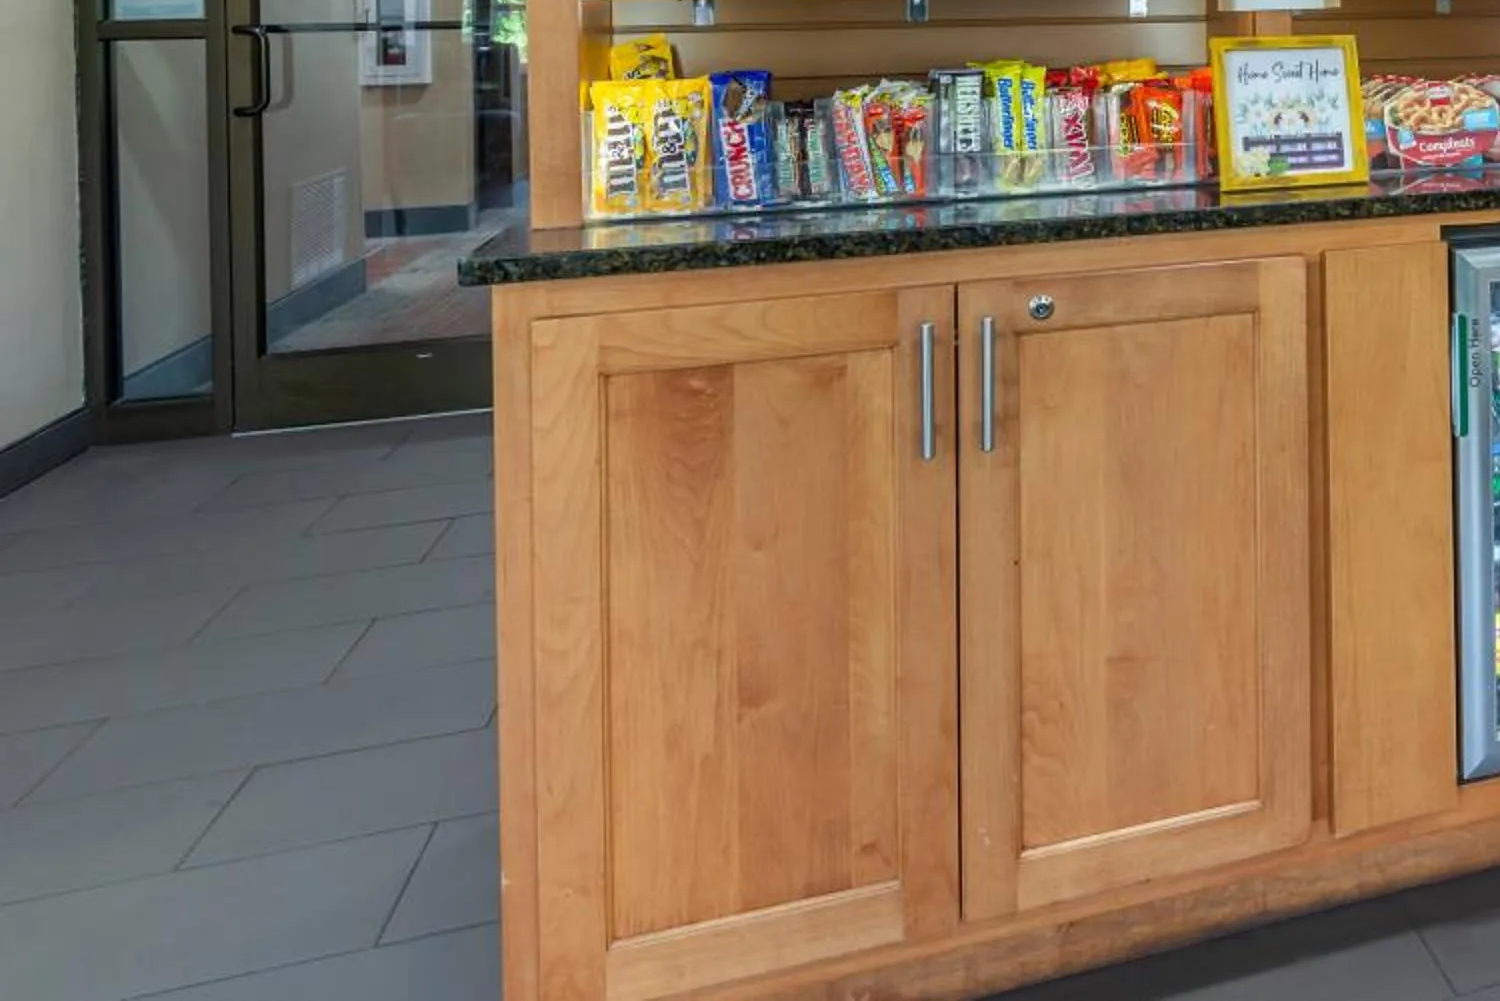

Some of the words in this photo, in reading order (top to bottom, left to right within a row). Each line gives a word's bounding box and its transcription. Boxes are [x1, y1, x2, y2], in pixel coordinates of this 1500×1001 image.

[956, 75, 981, 151] HERSHEY'S
[998, 78, 1014, 149] Butterfinger
[722, 120, 756, 199] CRUNCH
[1418, 136, 1476, 154] Compleats
[1470, 318, 1479, 348] Here
[1470, 353, 1482, 388] Open
